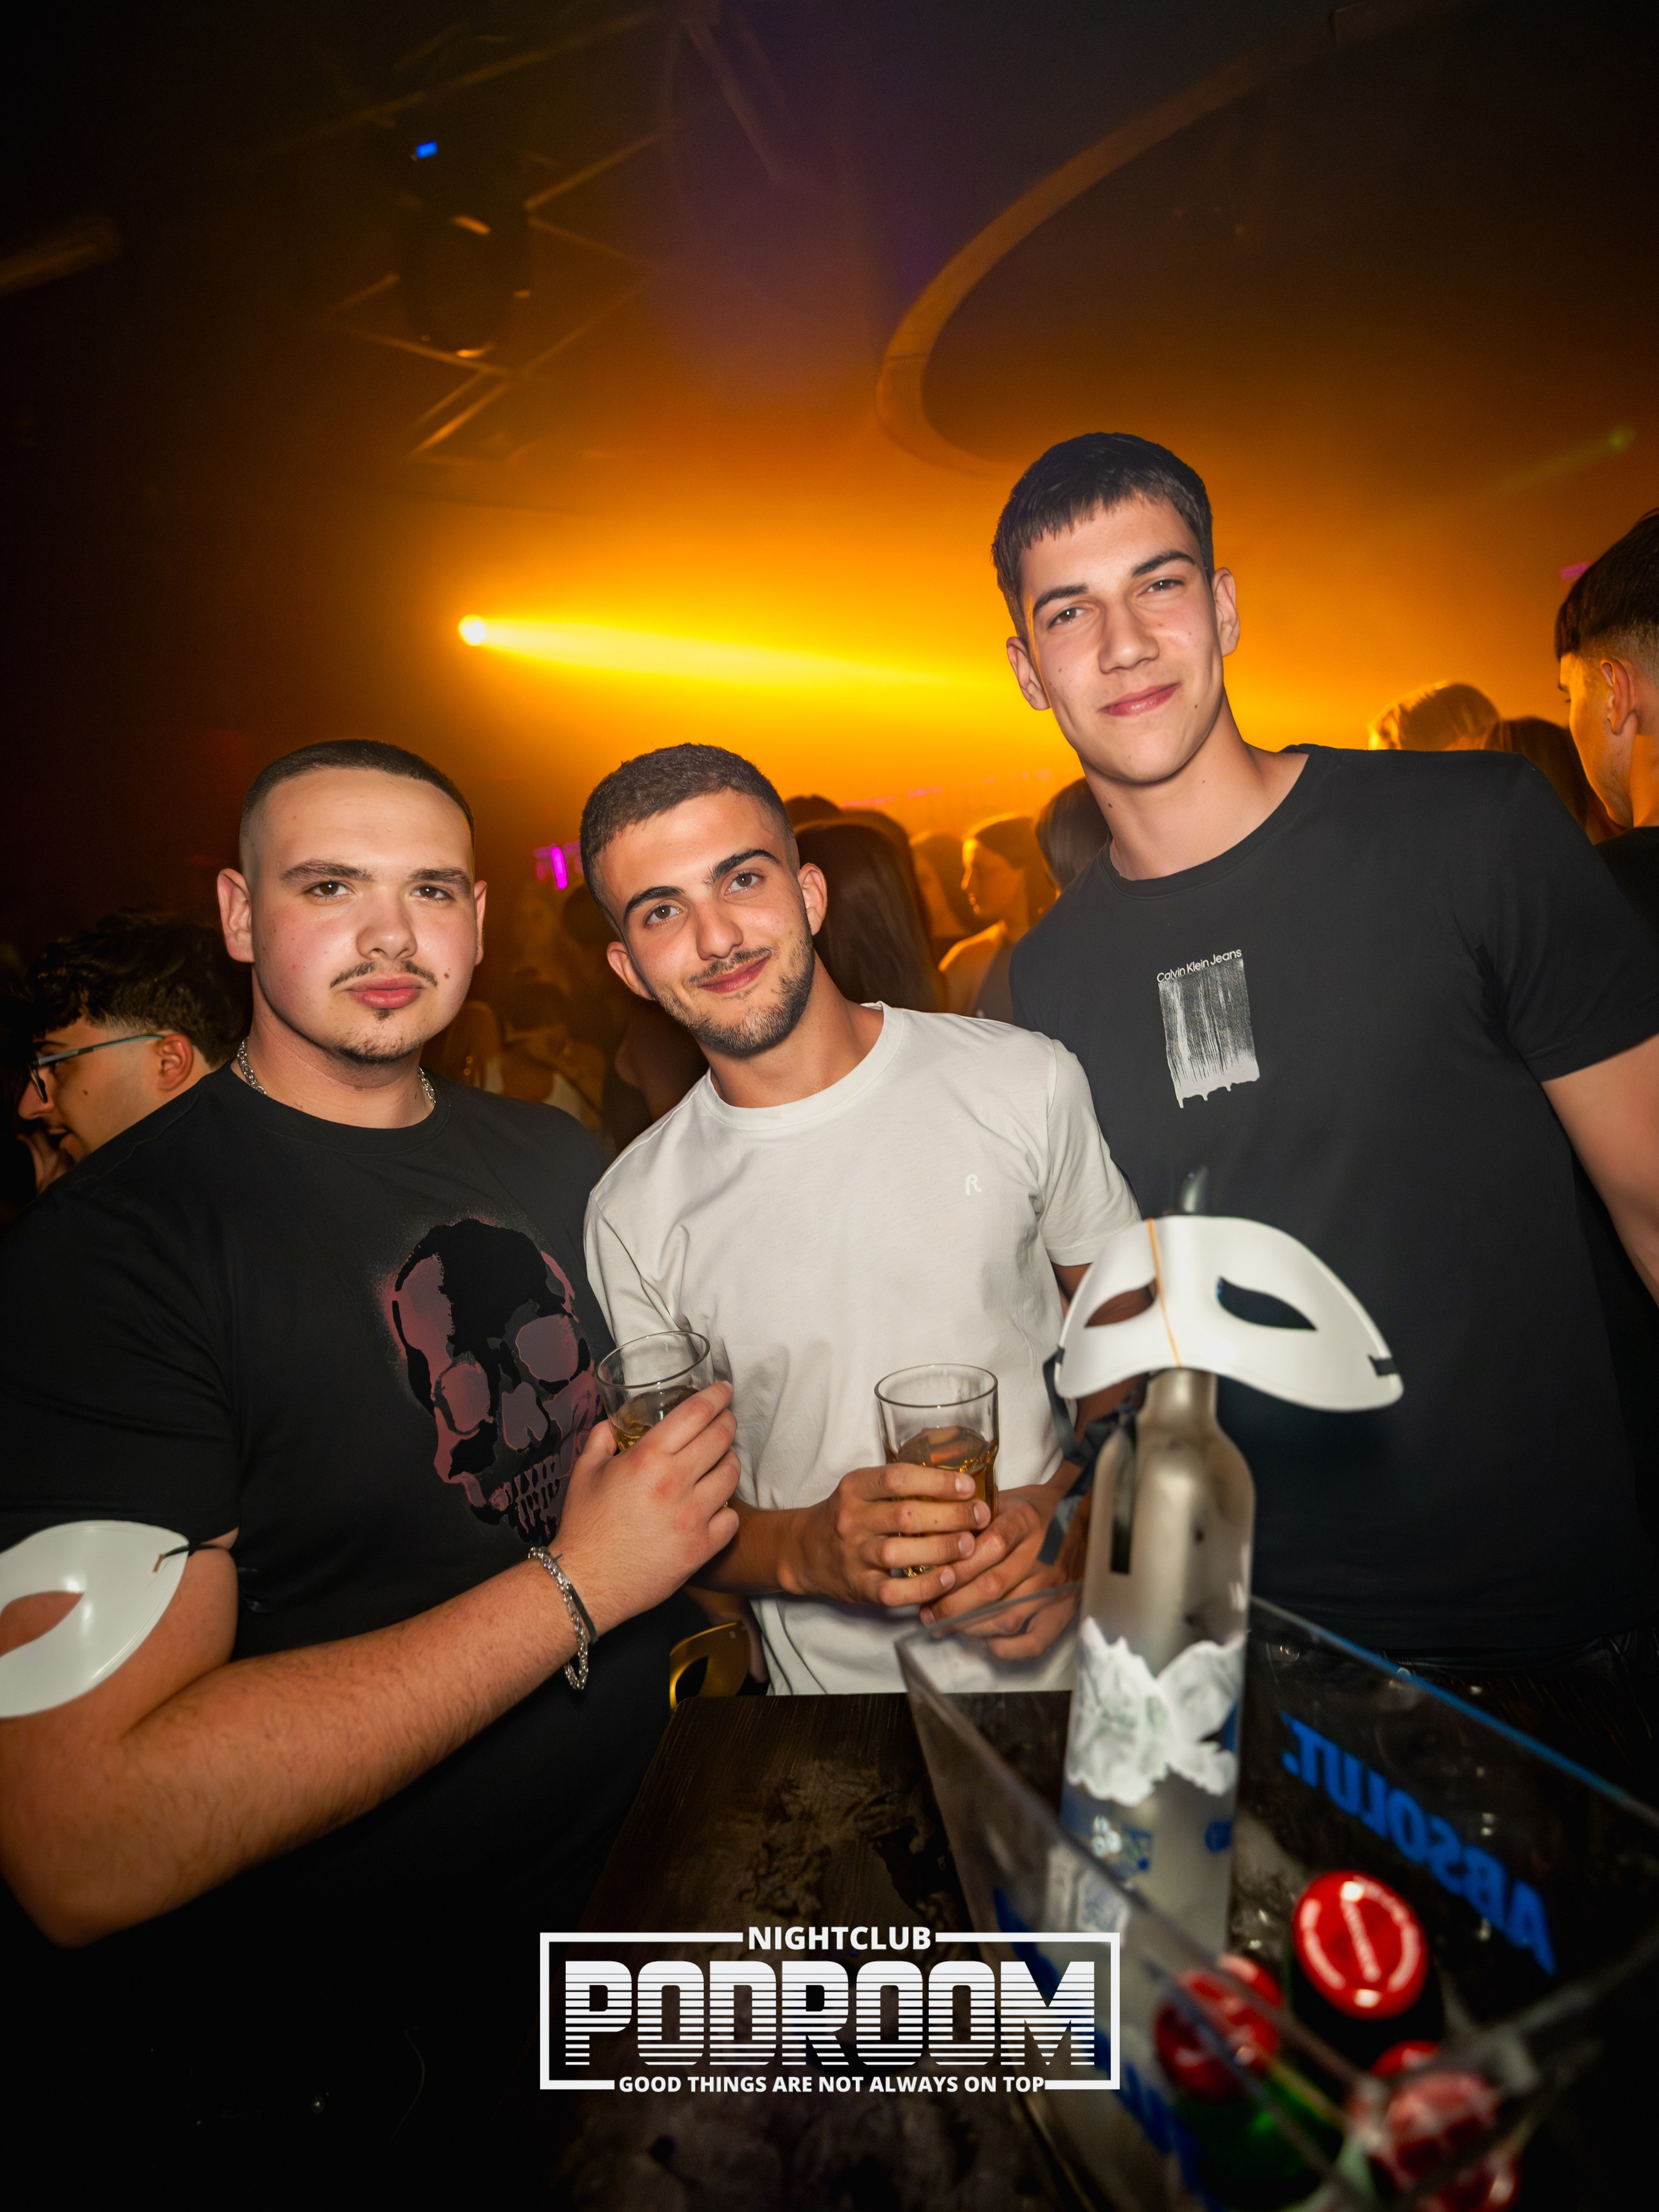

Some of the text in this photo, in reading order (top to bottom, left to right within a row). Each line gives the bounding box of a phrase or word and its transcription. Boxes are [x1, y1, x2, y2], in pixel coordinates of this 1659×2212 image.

[1156, 949, 1242, 983] Calvin Klein Jeans
